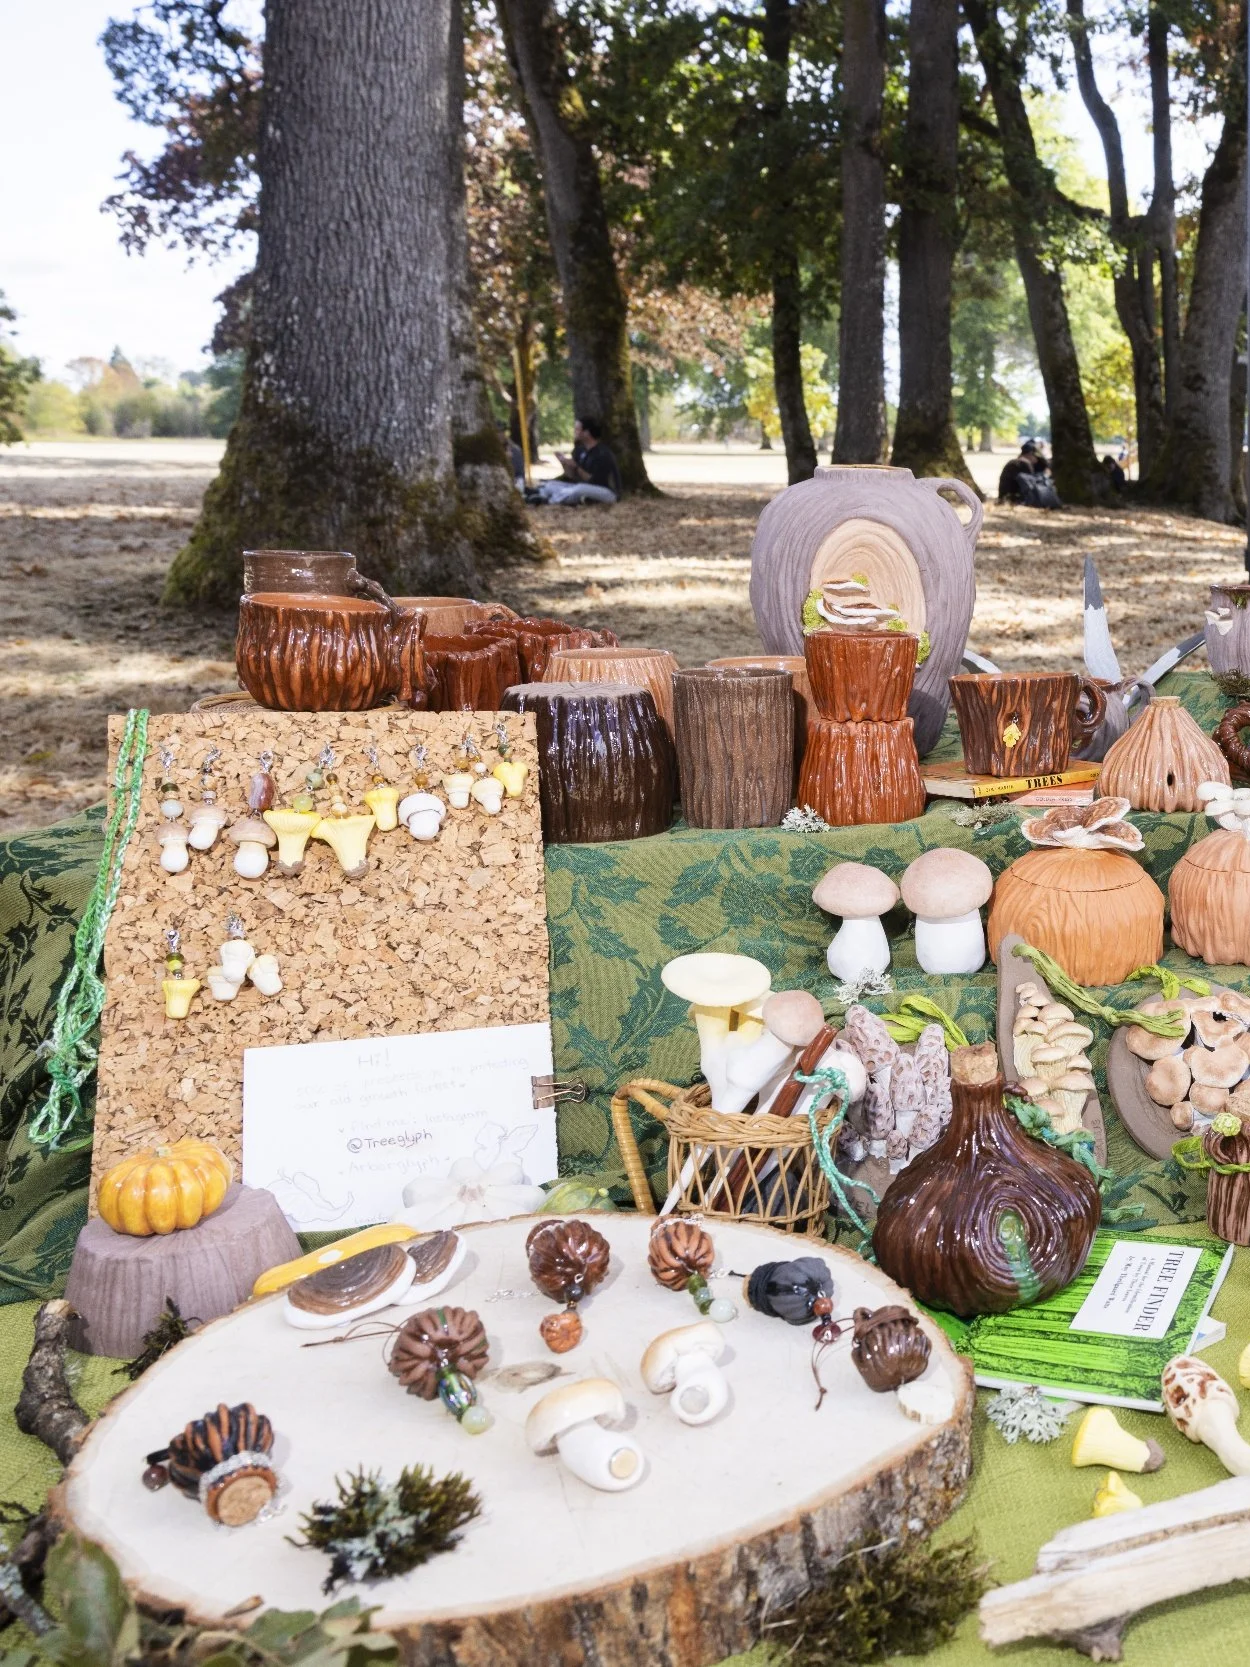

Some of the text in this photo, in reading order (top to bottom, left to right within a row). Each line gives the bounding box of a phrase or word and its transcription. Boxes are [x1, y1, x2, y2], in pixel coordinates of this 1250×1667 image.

[1026, 775, 1063, 789] TREES
[357, 1046, 392, 1069] Hi!
[346, 1129, 433, 1154] @Treeglyph
[1133, 1250, 1184, 1331] TREE FINDER
